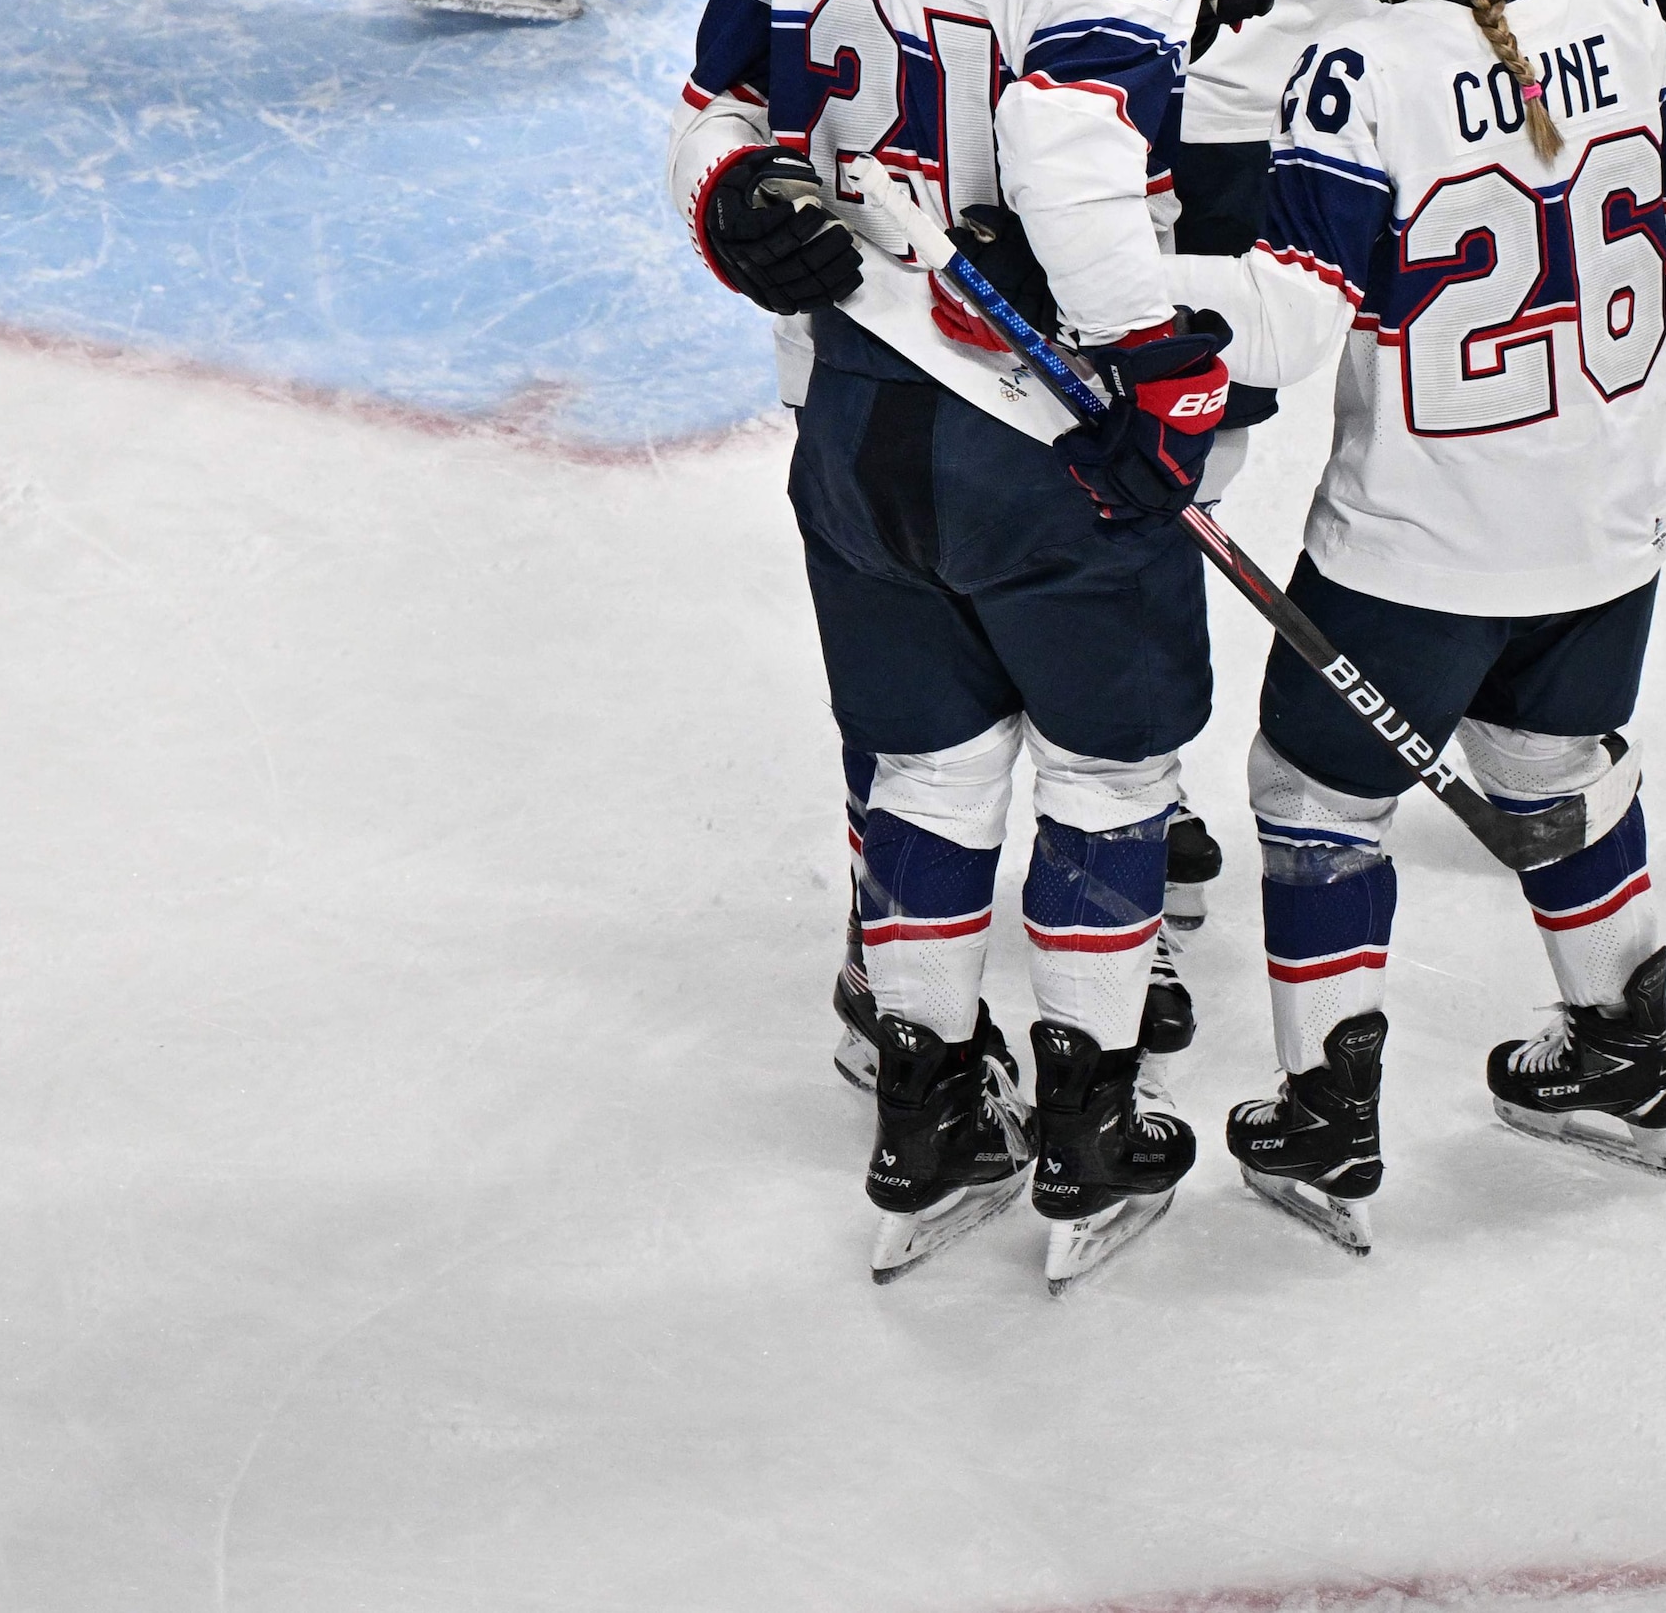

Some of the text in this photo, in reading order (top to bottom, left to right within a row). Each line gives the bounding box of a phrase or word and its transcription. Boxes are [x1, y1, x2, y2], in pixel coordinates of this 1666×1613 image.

[1109, 364, 1126, 398] KNIGHT
[1345, 1032, 1379, 1046] CCM
[1536, 1083, 1581, 1098] CCM
[1250, 1139, 1286, 1152] CCM
